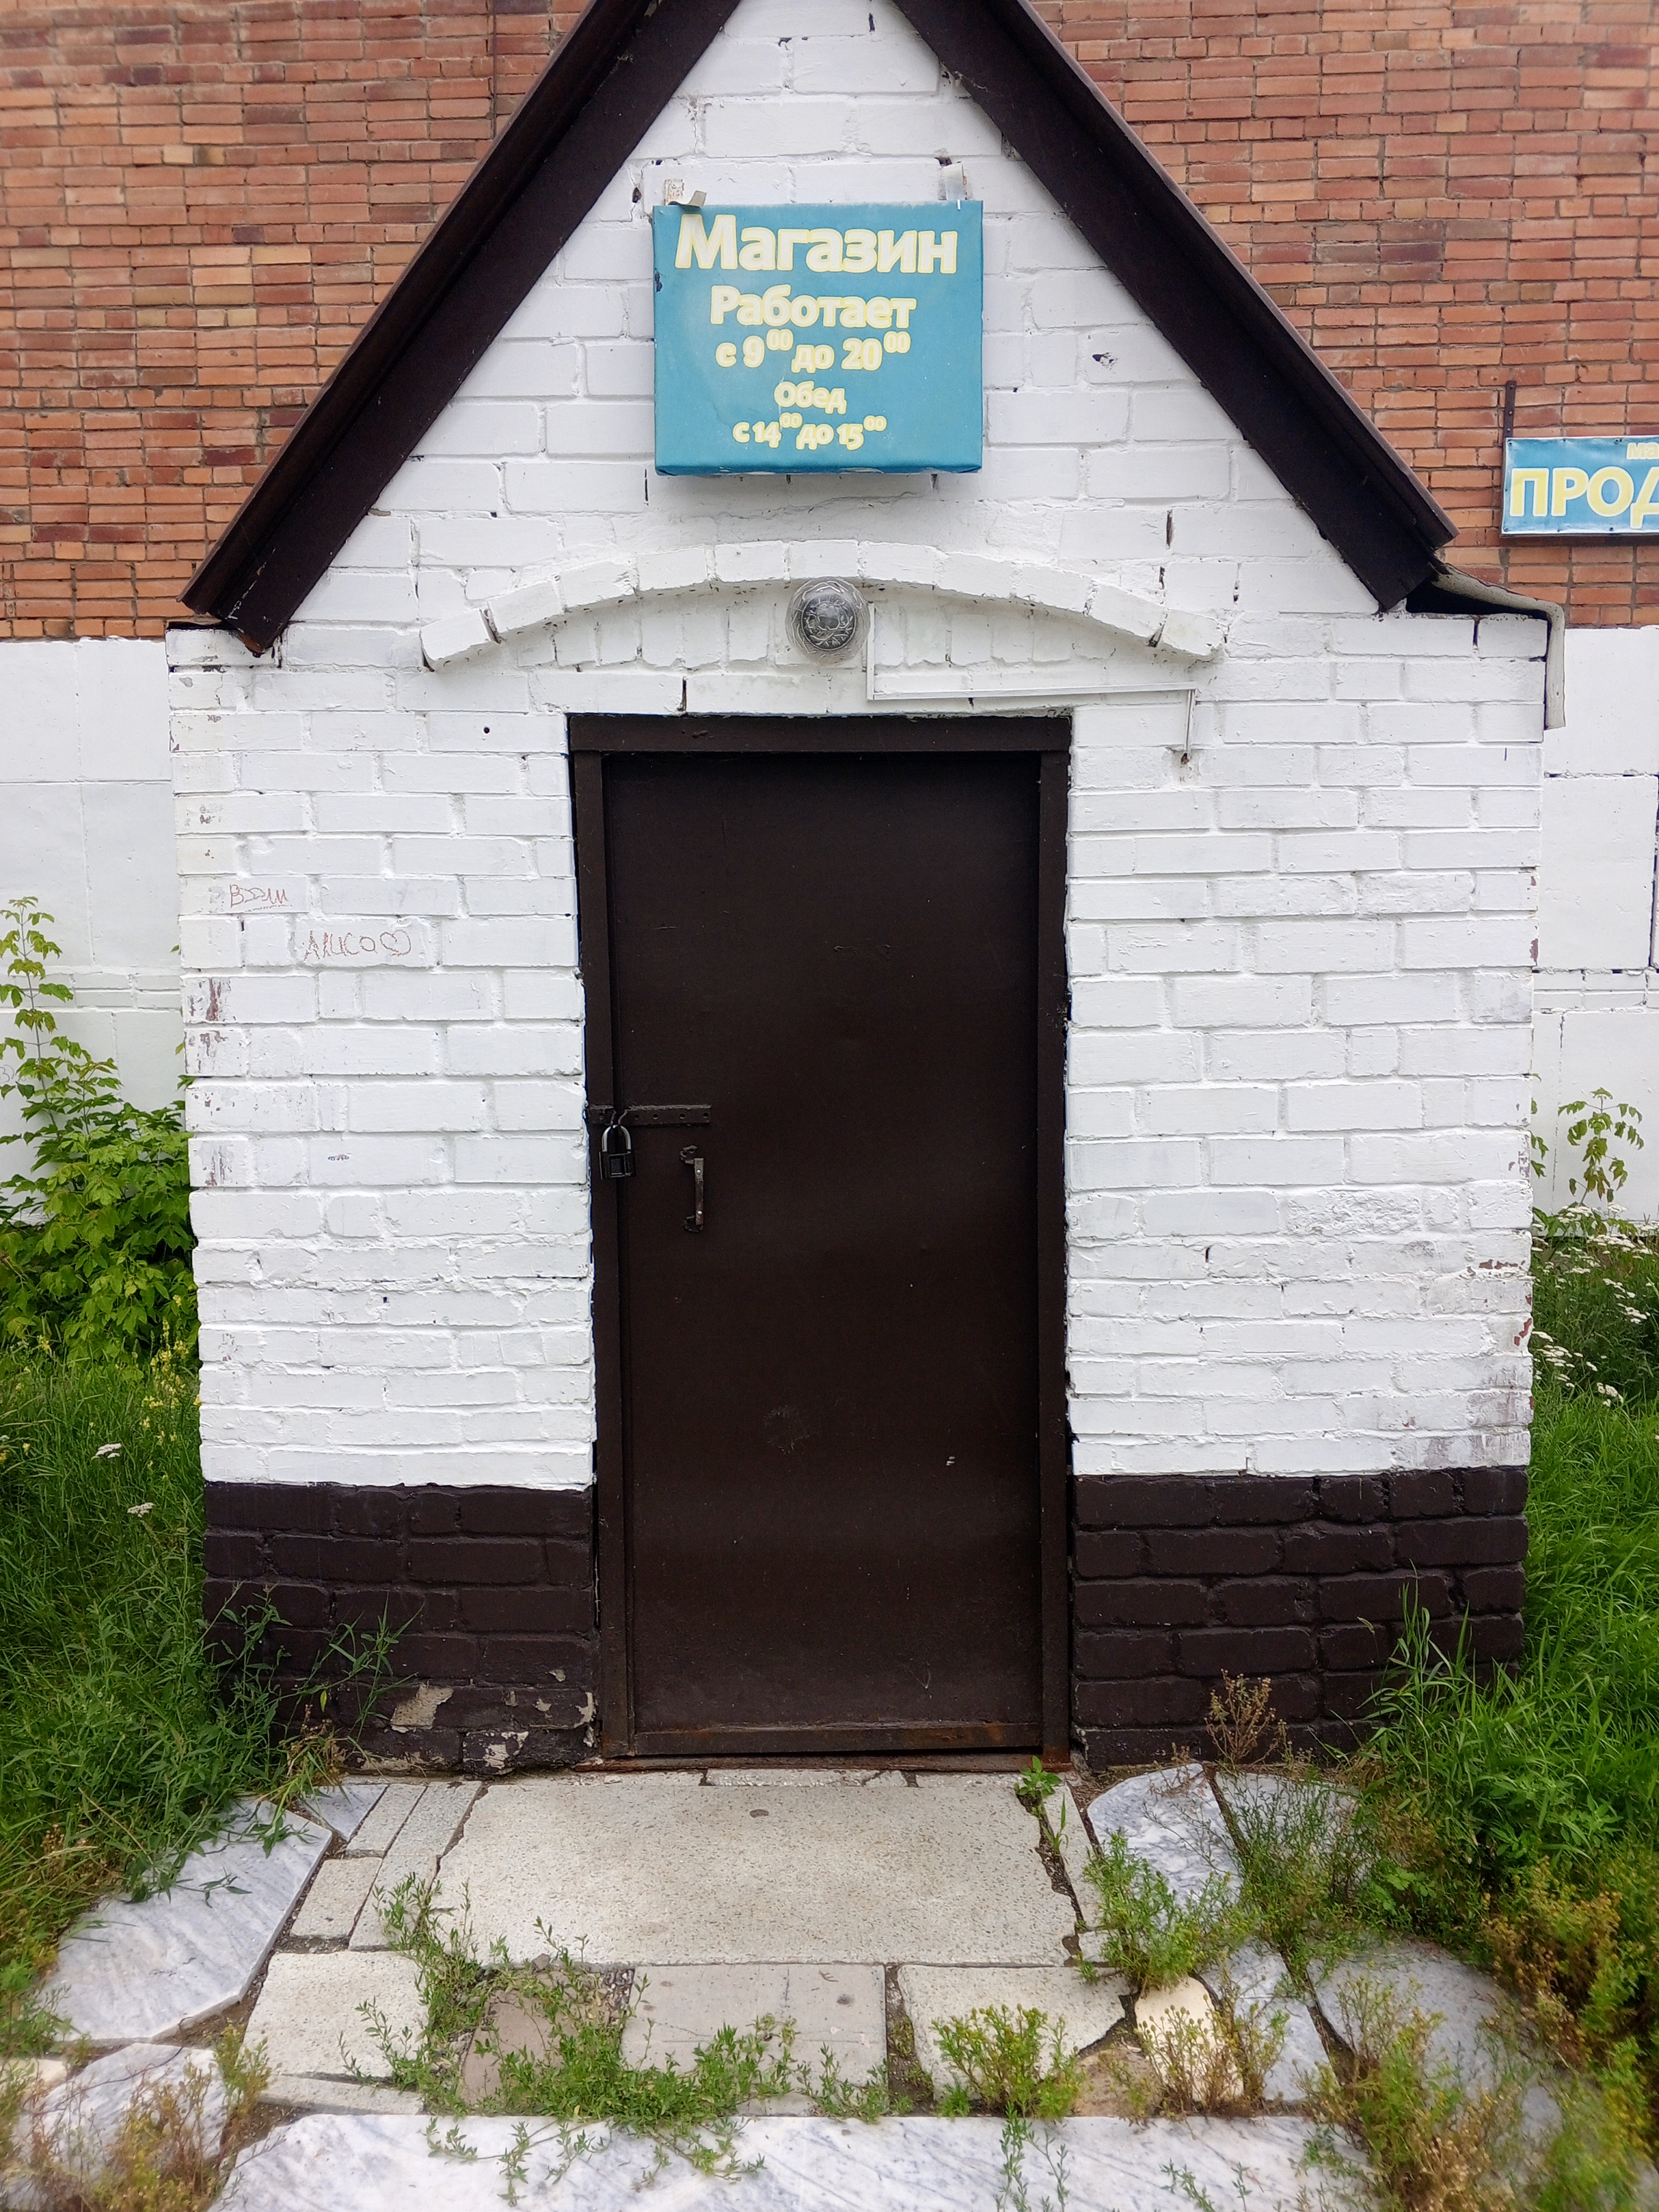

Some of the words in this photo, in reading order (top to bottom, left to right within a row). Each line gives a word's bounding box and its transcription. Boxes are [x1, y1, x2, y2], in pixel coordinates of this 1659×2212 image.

[674, 213, 958, 274] Магазин
[710, 284, 917, 328] Работает
[791, 345, 835, 373] до
[774, 381, 847, 414] Обед
[796, 423, 834, 450] до
